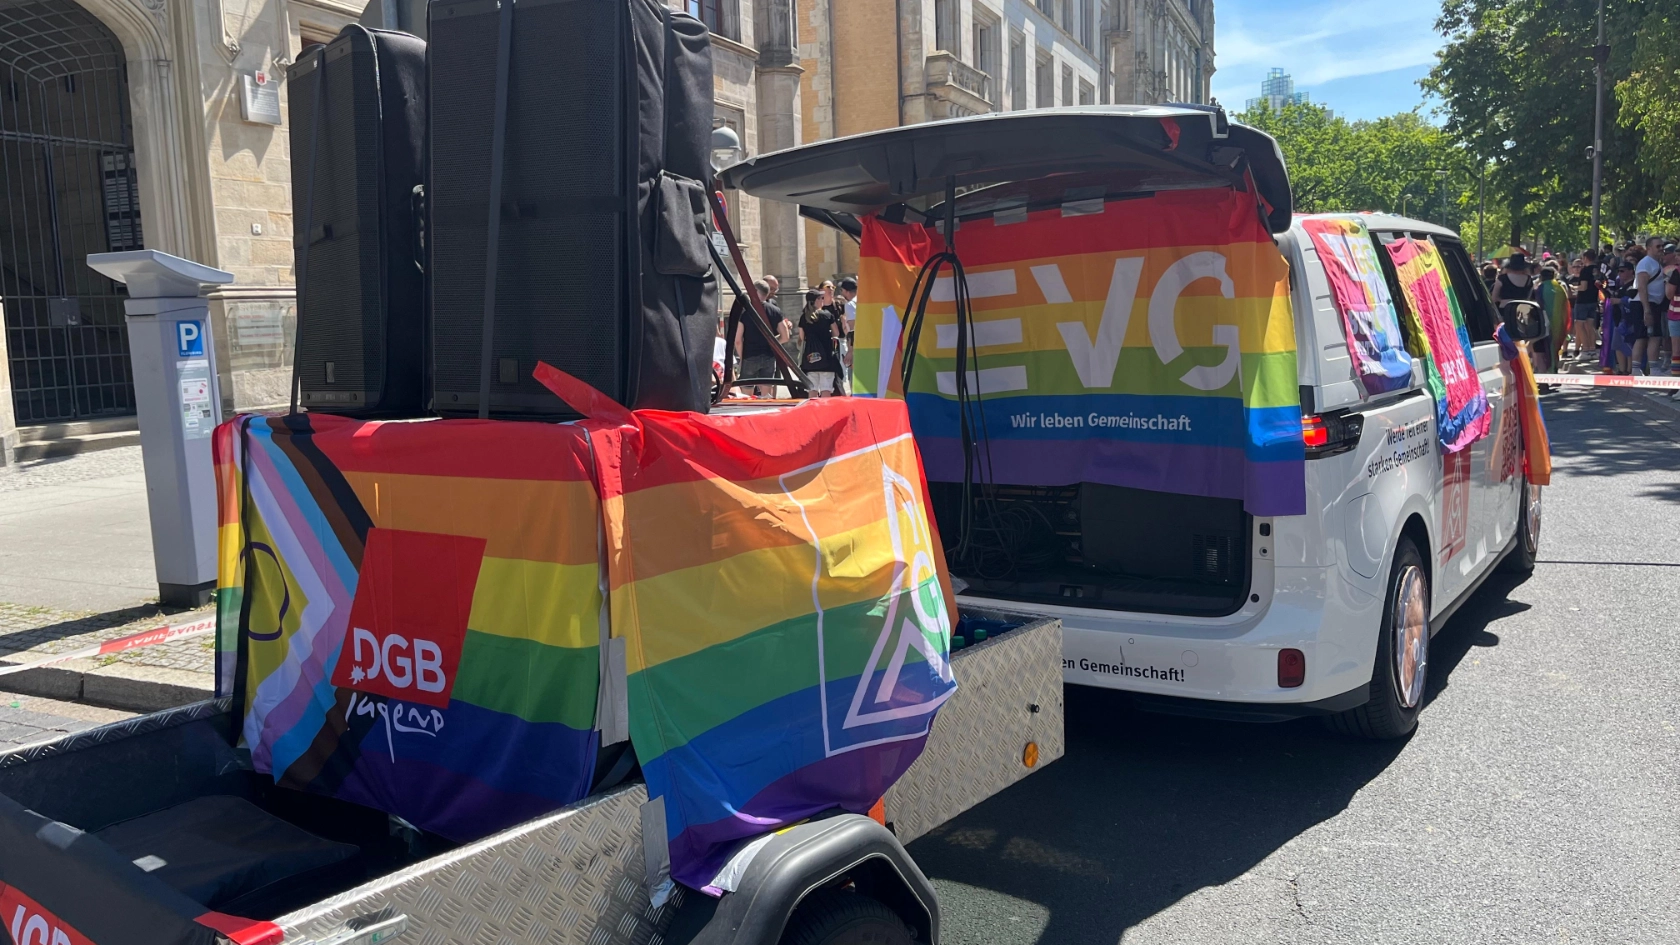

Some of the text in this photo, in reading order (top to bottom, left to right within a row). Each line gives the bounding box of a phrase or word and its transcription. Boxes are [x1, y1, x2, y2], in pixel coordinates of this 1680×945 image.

[179, 323, 199, 351] P
[930, 251, 1242, 395] EVG
[1010, 412, 1192, 431] Wir leben Gemeinschaft
[1387, 424, 1406, 446] Werde
[1368, 439, 1429, 477] starken Gemeinschaft!
[352, 627, 446, 693] DGB
[1080, 658, 1185, 682] Gemeinschaft!
